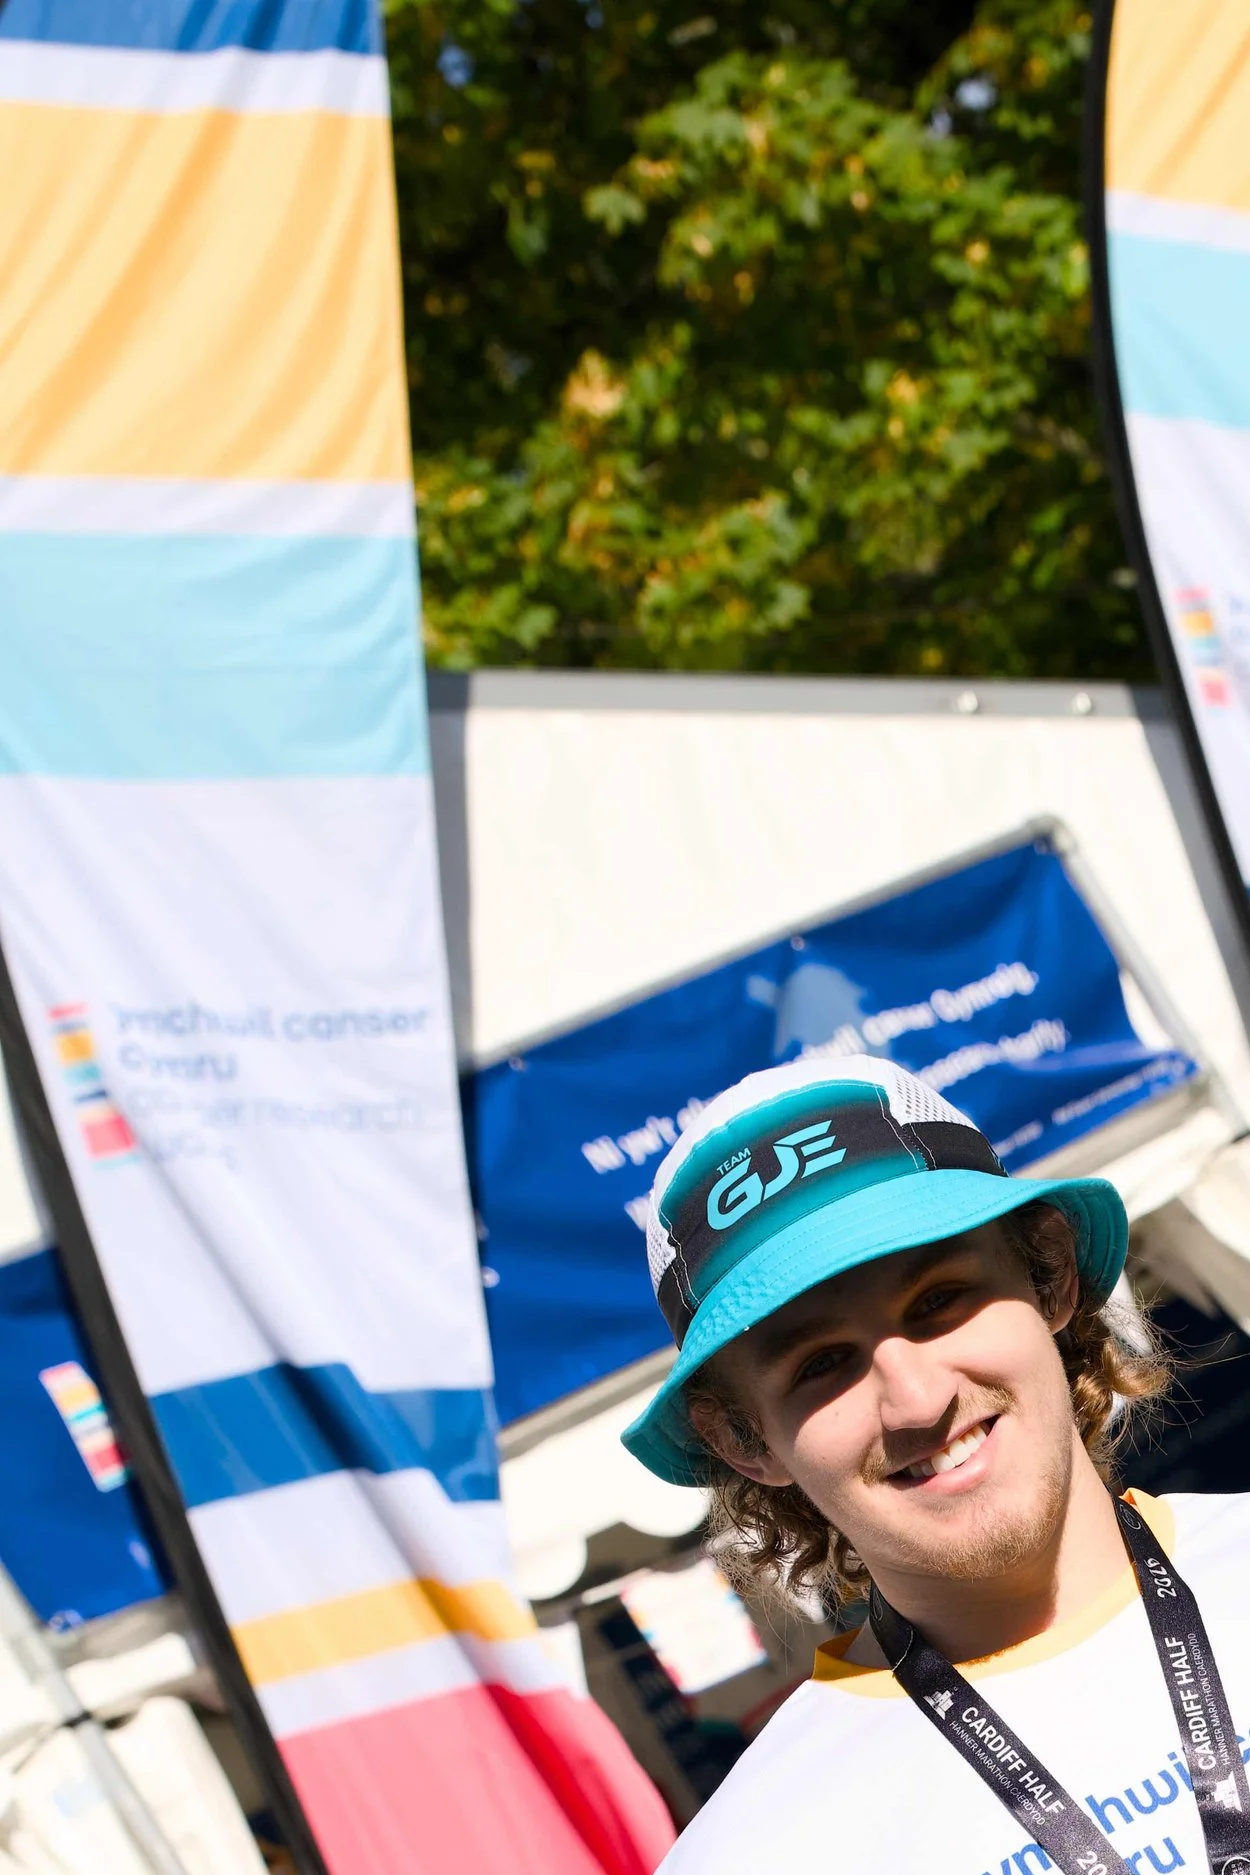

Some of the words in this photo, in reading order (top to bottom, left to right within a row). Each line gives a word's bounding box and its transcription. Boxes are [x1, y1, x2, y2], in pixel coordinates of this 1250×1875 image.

[706, 1119, 848, 1231] GJE
[716, 1147, 752, 1176] TEAM
[1144, 1557, 1178, 1599] 2026
[1164, 1635, 1195, 1685] HALF
[1187, 1632, 1208, 1676] CAERDYDD
[1199, 1673, 1222, 1727] MARATHON
[1179, 1689, 1217, 1771] CARDIFF
[1213, 1724, 1231, 1766] HANNER
[948, 1720, 979, 1752] HANNER
[974, 1747, 1013, 1790] MARATHON
[1009, 1786, 1047, 1826] CAERDYDD
[961, 1706, 1028, 1773] CARDIFF
[1018, 1770, 1066, 1815] HALF
